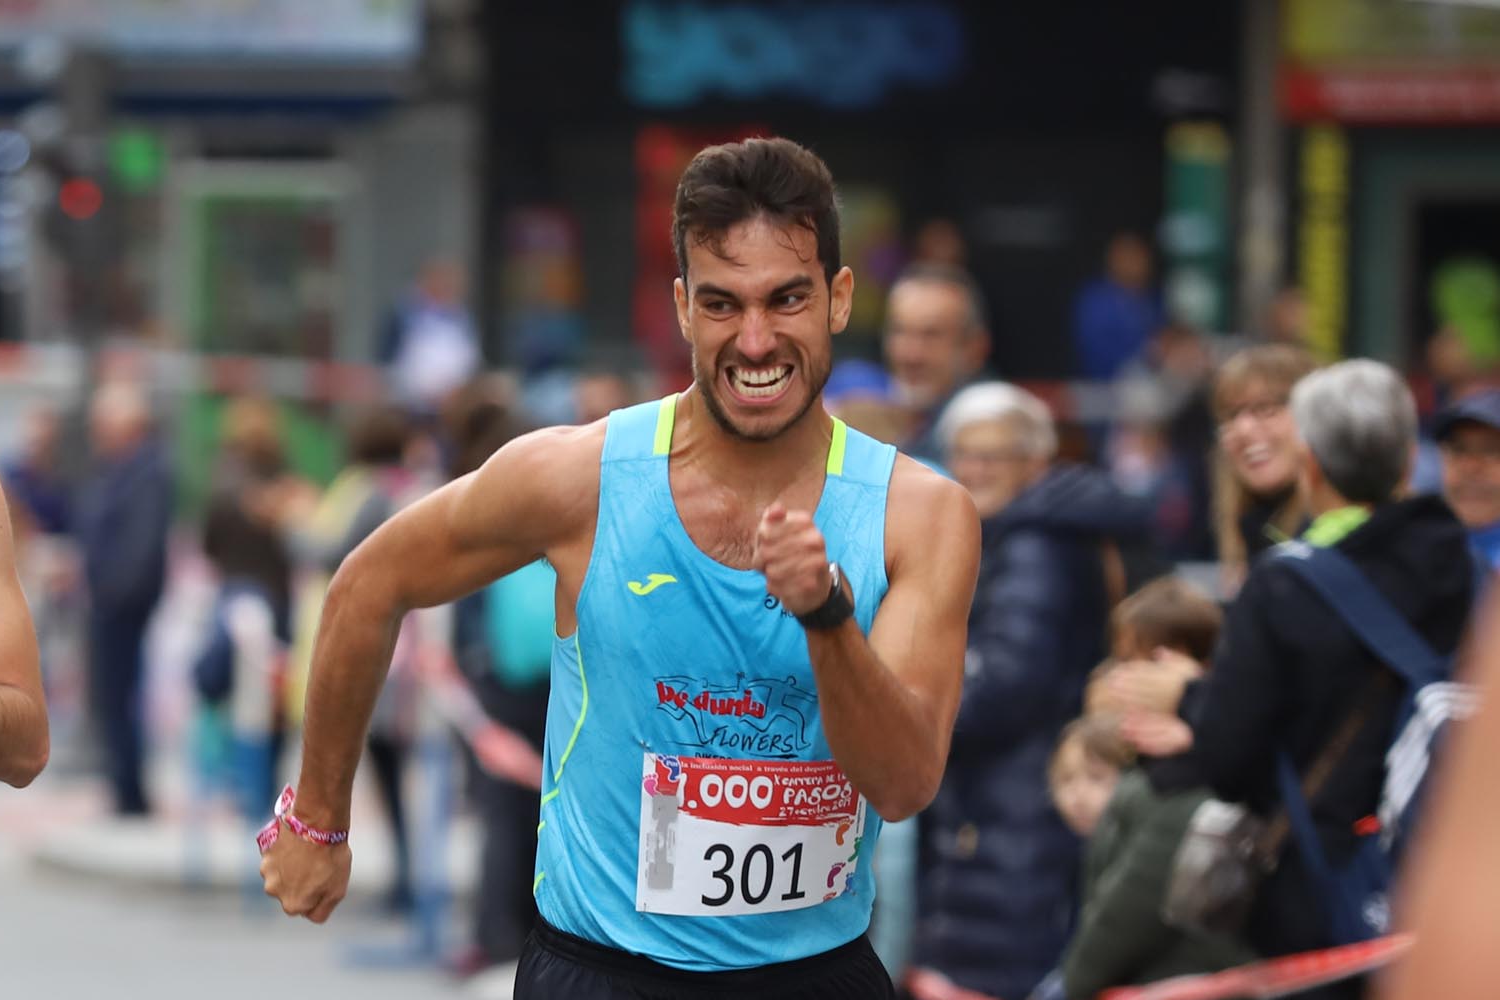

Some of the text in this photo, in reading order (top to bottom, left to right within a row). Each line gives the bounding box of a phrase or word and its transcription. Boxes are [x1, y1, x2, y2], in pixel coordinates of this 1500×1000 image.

[710, 725, 793, 753] FLOWERS
[781, 776, 823, 786] CARRERA
[790, 765, 803, 773] del
[804, 765, 834, 774] deporte
[676, 773, 774, 810] 1.000
[783, 781, 852, 806] PASOS
[779, 806, 794, 817] 27
[701, 842, 806, 907] 301
